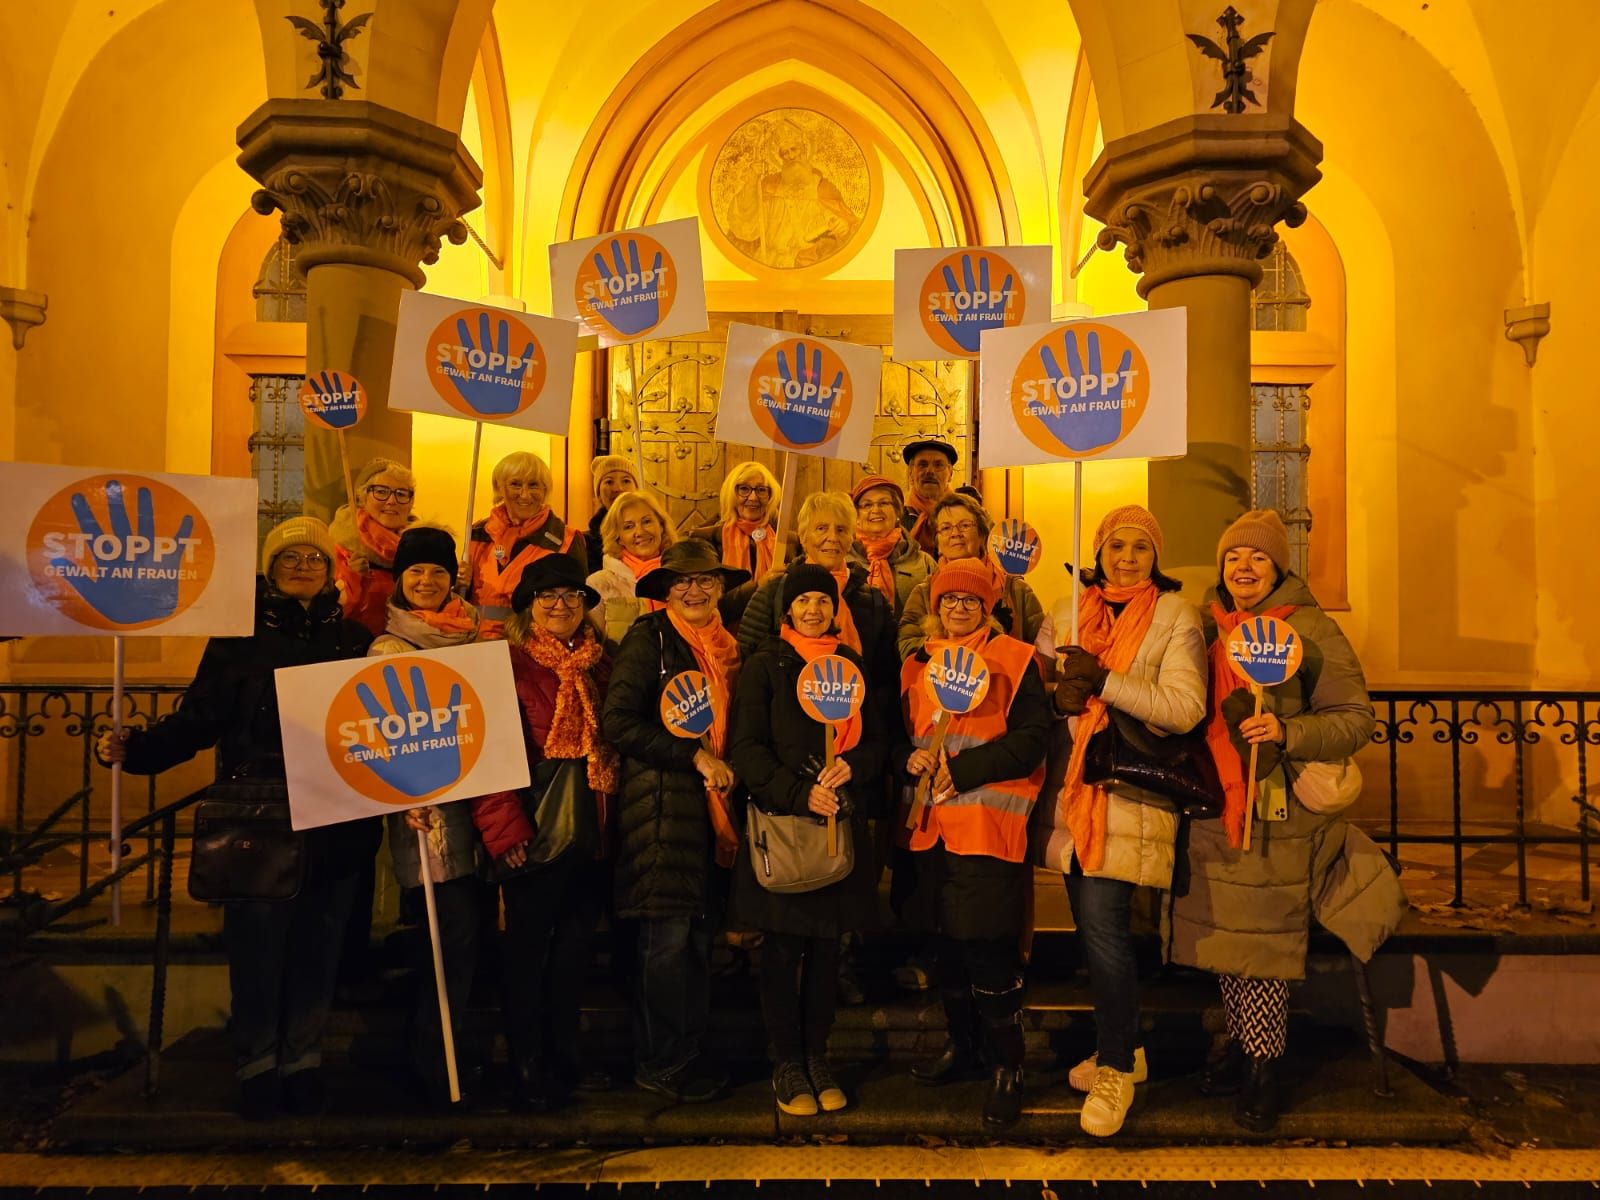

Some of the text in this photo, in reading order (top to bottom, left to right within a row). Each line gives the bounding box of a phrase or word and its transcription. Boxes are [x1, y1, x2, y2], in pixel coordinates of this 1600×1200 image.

[583, 267, 668, 299] STOPPT
[585, 290, 669, 311] GEWALT AN FRAUEN
[928, 290, 1018, 310] STOPPT
[928, 312, 1015, 322] GEWALT AN FRAUEN
[436, 343, 539, 378] STOPPT
[436, 366, 535, 390] GEWALT AN FRAUEN
[1021, 370, 1139, 402] STOPPT
[302, 390, 361, 406] STOPPT
[757, 375, 846, 406] STOPPT
[757, 398, 841, 419] GEWALT AN FRAUEN
[1023, 399, 1136, 417] GEWALT AN FRAUEN
[42, 531, 202, 564] STOPPT
[991, 534, 1039, 554] STOPPT
[43, 566, 198, 580] GEWALT AN FRAUEN
[1229, 640, 1298, 657] STOPPT
[928, 662, 986, 691] STOPPT
[802, 679, 861, 697] STOPPT
[665, 685, 711, 723] STOPPT
[338, 703, 471, 747] STOPPT
[343, 733, 474, 763] GEWALT AN FRAUEN
